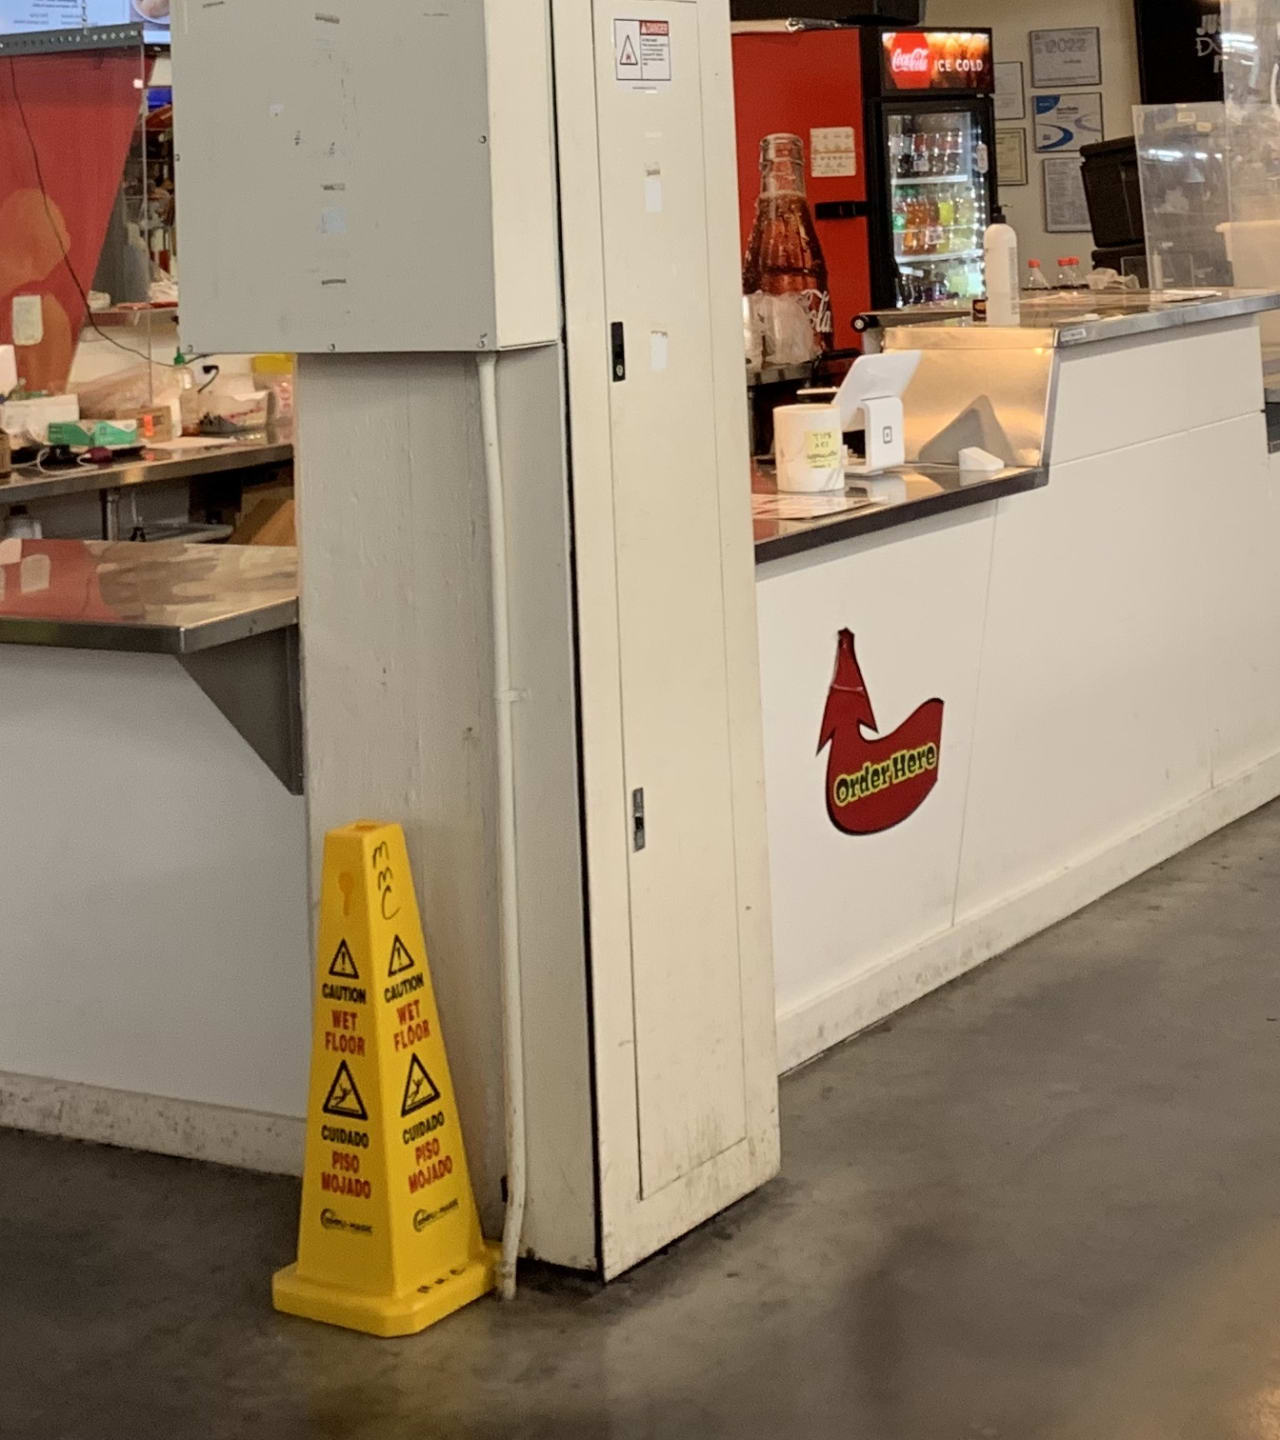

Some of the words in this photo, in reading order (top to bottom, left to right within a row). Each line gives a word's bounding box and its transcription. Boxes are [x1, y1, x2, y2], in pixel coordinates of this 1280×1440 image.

[934, 59, 952, 72] ICE
[955, 59, 984, 72] COLD
[834, 761, 892, 806] Order
[891, 742, 937, 782] Here
[322, 982, 367, 1005] CAUTION
[383, 972, 424, 1004] CAUTION
[331, 1009, 358, 1031] WET
[396, 998, 420, 1026] WET
[324, 1031, 366, 1057] FLOOR
[393, 1019, 431, 1052] FLOOR
[321, 1124, 370, 1149] CUIDADO
[402, 1111, 445, 1145] CUIDADO
[331, 1150, 360, 1174] PISO
[414, 1137, 441, 1166] PISO
[321, 1171, 372, 1200] MOJADO
[407, 1154, 454, 1195] MOJADO
